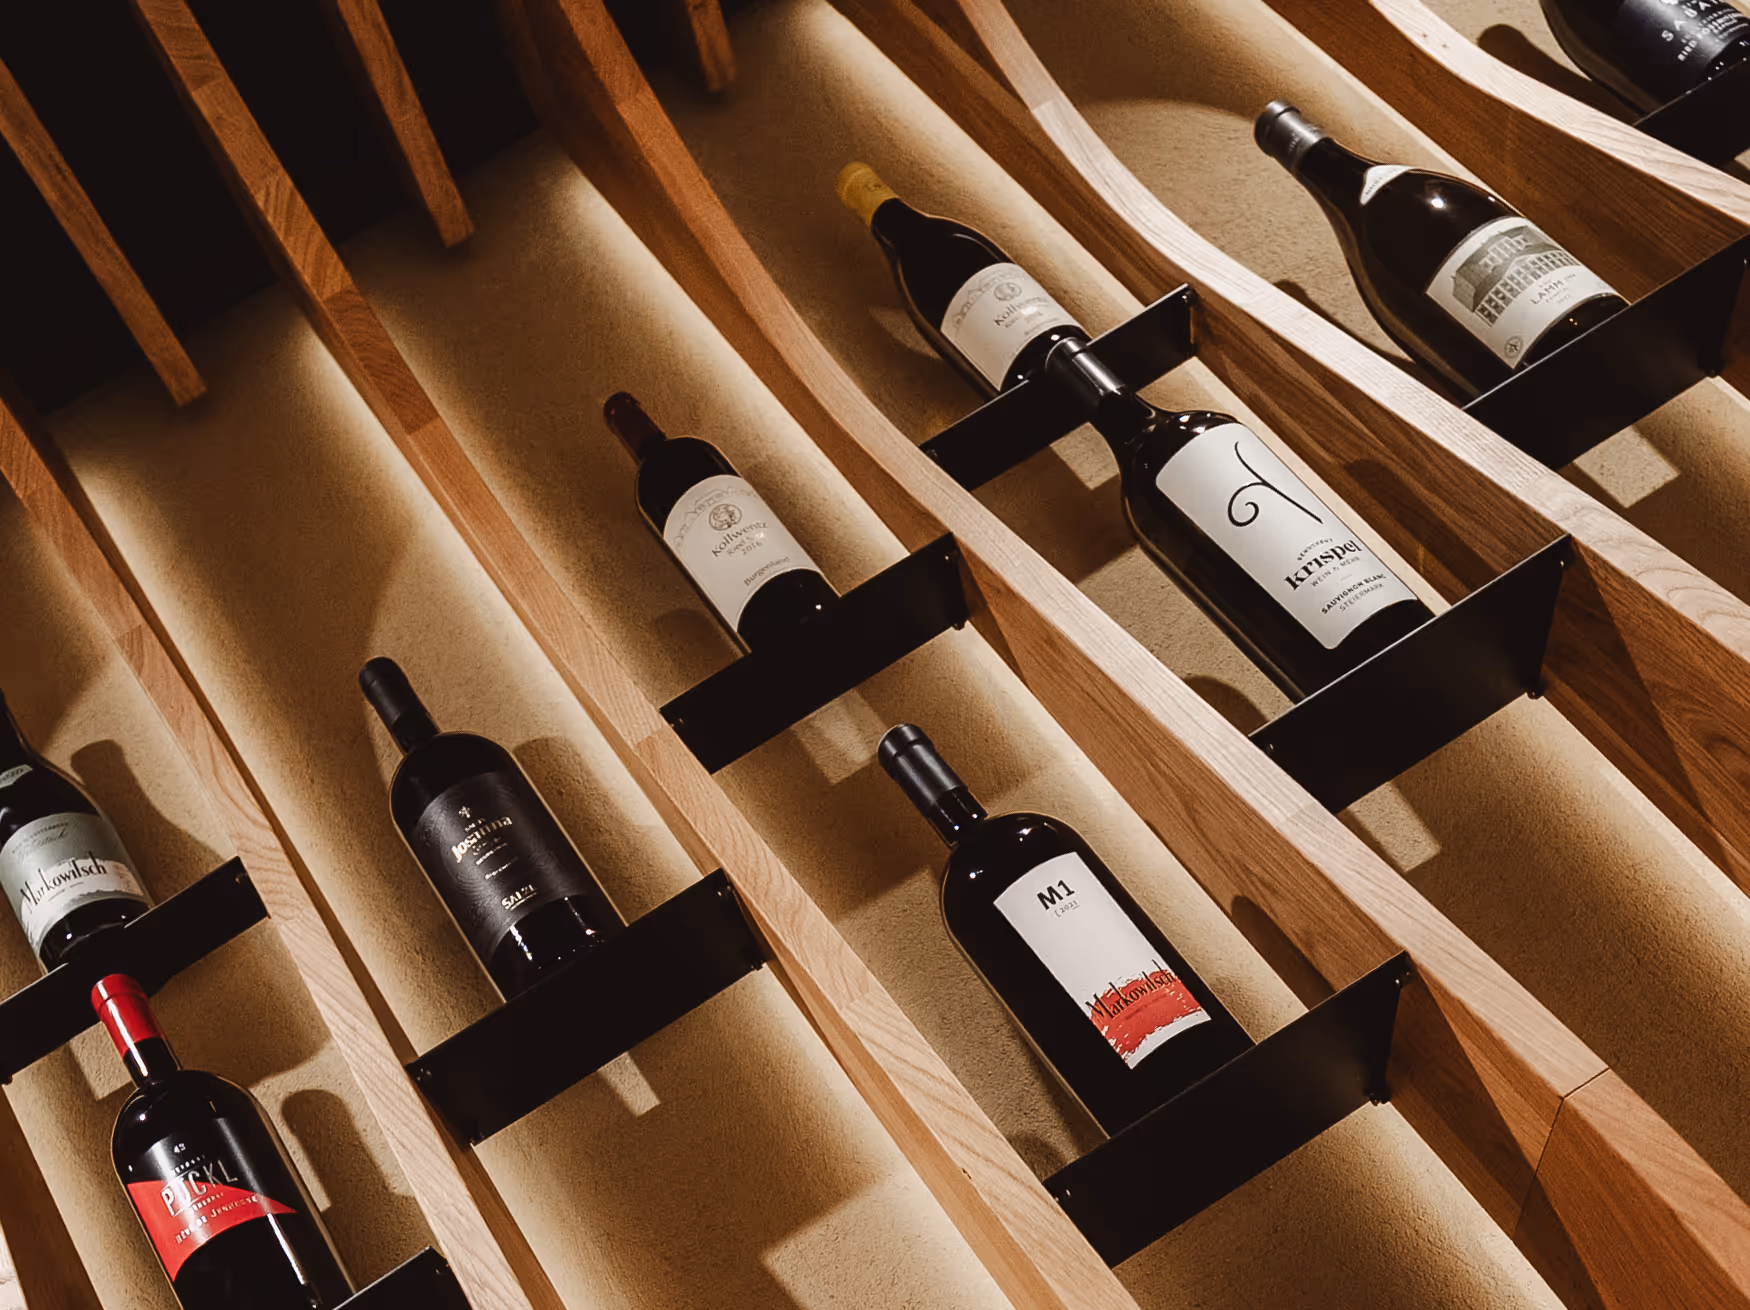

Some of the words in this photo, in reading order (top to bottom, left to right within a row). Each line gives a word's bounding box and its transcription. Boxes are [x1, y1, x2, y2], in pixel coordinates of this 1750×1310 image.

[1530, 279, 1562, 305] LAMM
[1284, 539, 1362, 591] krispel
[1311, 571, 1332, 587] WEIN
[1320, 581, 1365, 614] SAUVIGNON
[1363, 573, 1387, 586] BLANC
[20, 850, 108, 916] Markowitsch
[1036, 879, 1076, 911] M1
[1085, 959, 1178, 1020] Markowitsch
